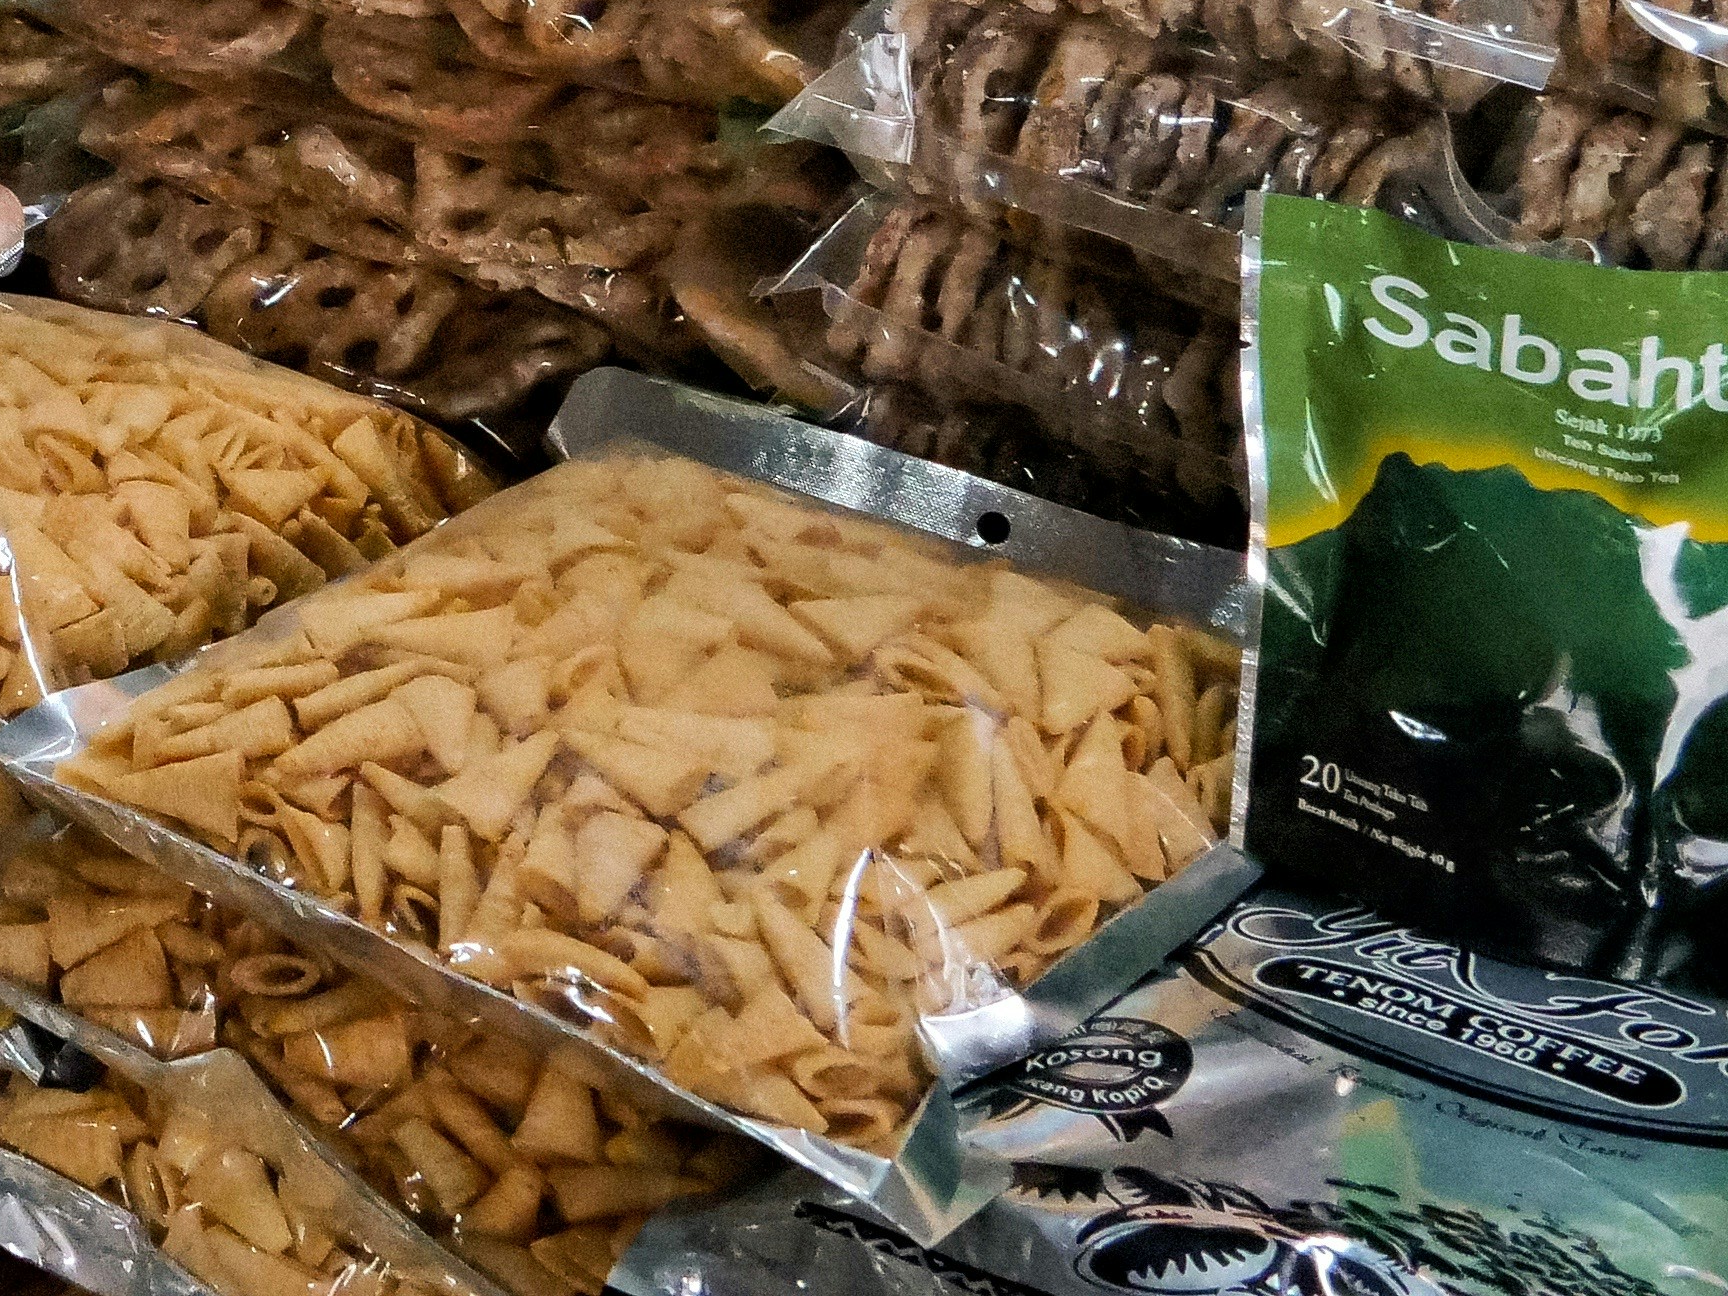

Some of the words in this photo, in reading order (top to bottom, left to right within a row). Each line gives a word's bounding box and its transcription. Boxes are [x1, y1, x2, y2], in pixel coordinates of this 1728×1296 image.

[1554, 409, 1608, 435] Sejak
[1616, 423, 1663, 443] 1973
[1299, 755, 1341, 793] 20
[1391, 835, 1427, 859] Weight
[1297, 963, 1456, 1016] TENOM
[1467, 1014, 1649, 1085] COFFEE
[1357, 995, 1446, 1031] since
[1457, 1026, 1538, 1063] 1960
[1025, 1048, 1162, 1073] Kosong
